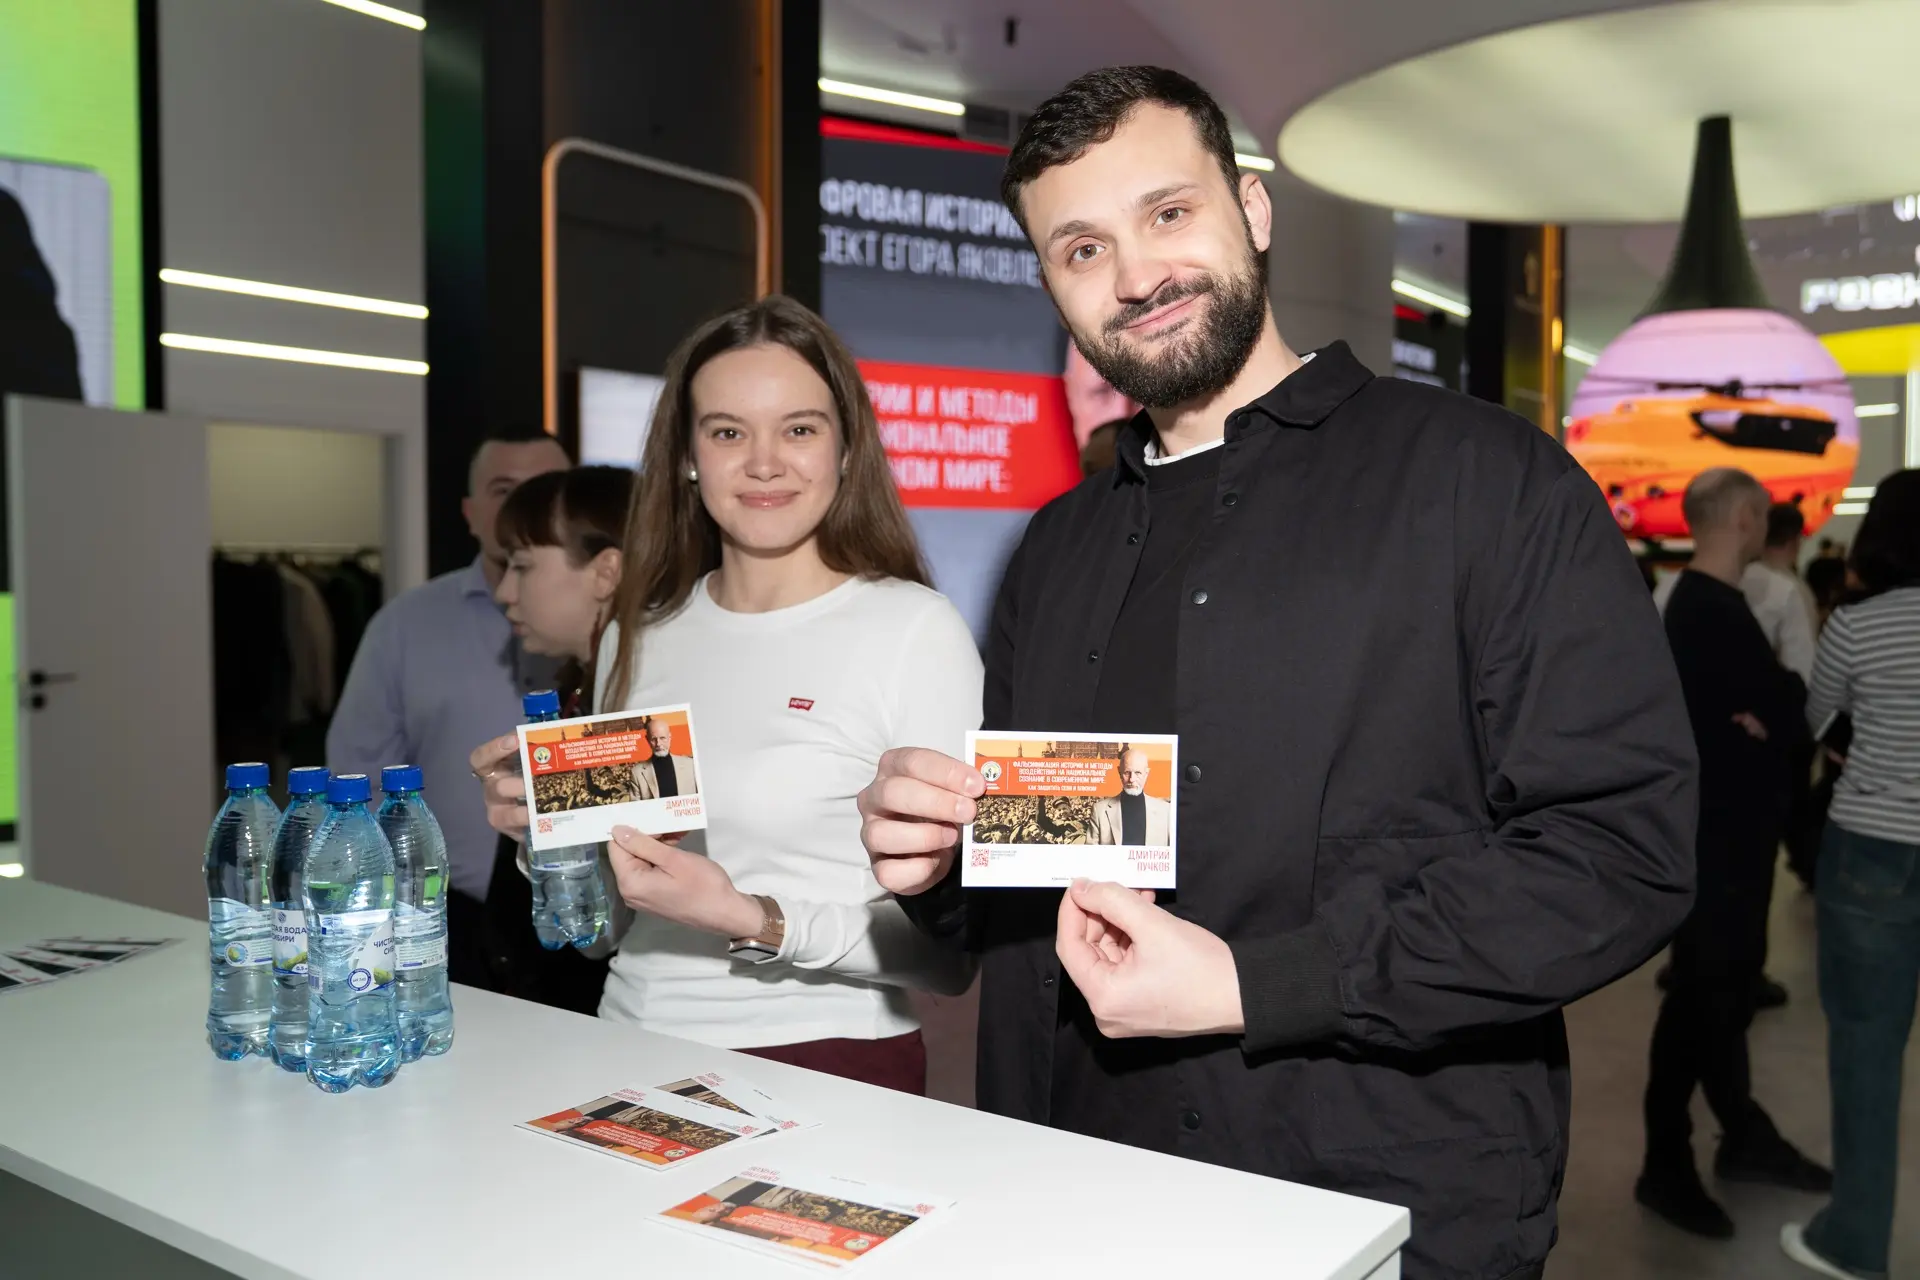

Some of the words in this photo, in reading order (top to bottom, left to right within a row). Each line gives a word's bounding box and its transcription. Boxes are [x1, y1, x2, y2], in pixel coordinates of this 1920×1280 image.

[882, 232, 956, 277] ЕГОРА
[916, 385, 935, 417] И
[939, 387, 1038, 424] МЕТОДЫ
[1090, 762, 1113, 770] МЕТОДЫ
[1058, 768, 1065, 776] НА
[1128, 849, 1170, 861] ДМИТРИЙ
[1137, 861, 1170, 872] ПУЧКОВ
[284, 926, 307, 935] ВОДА
